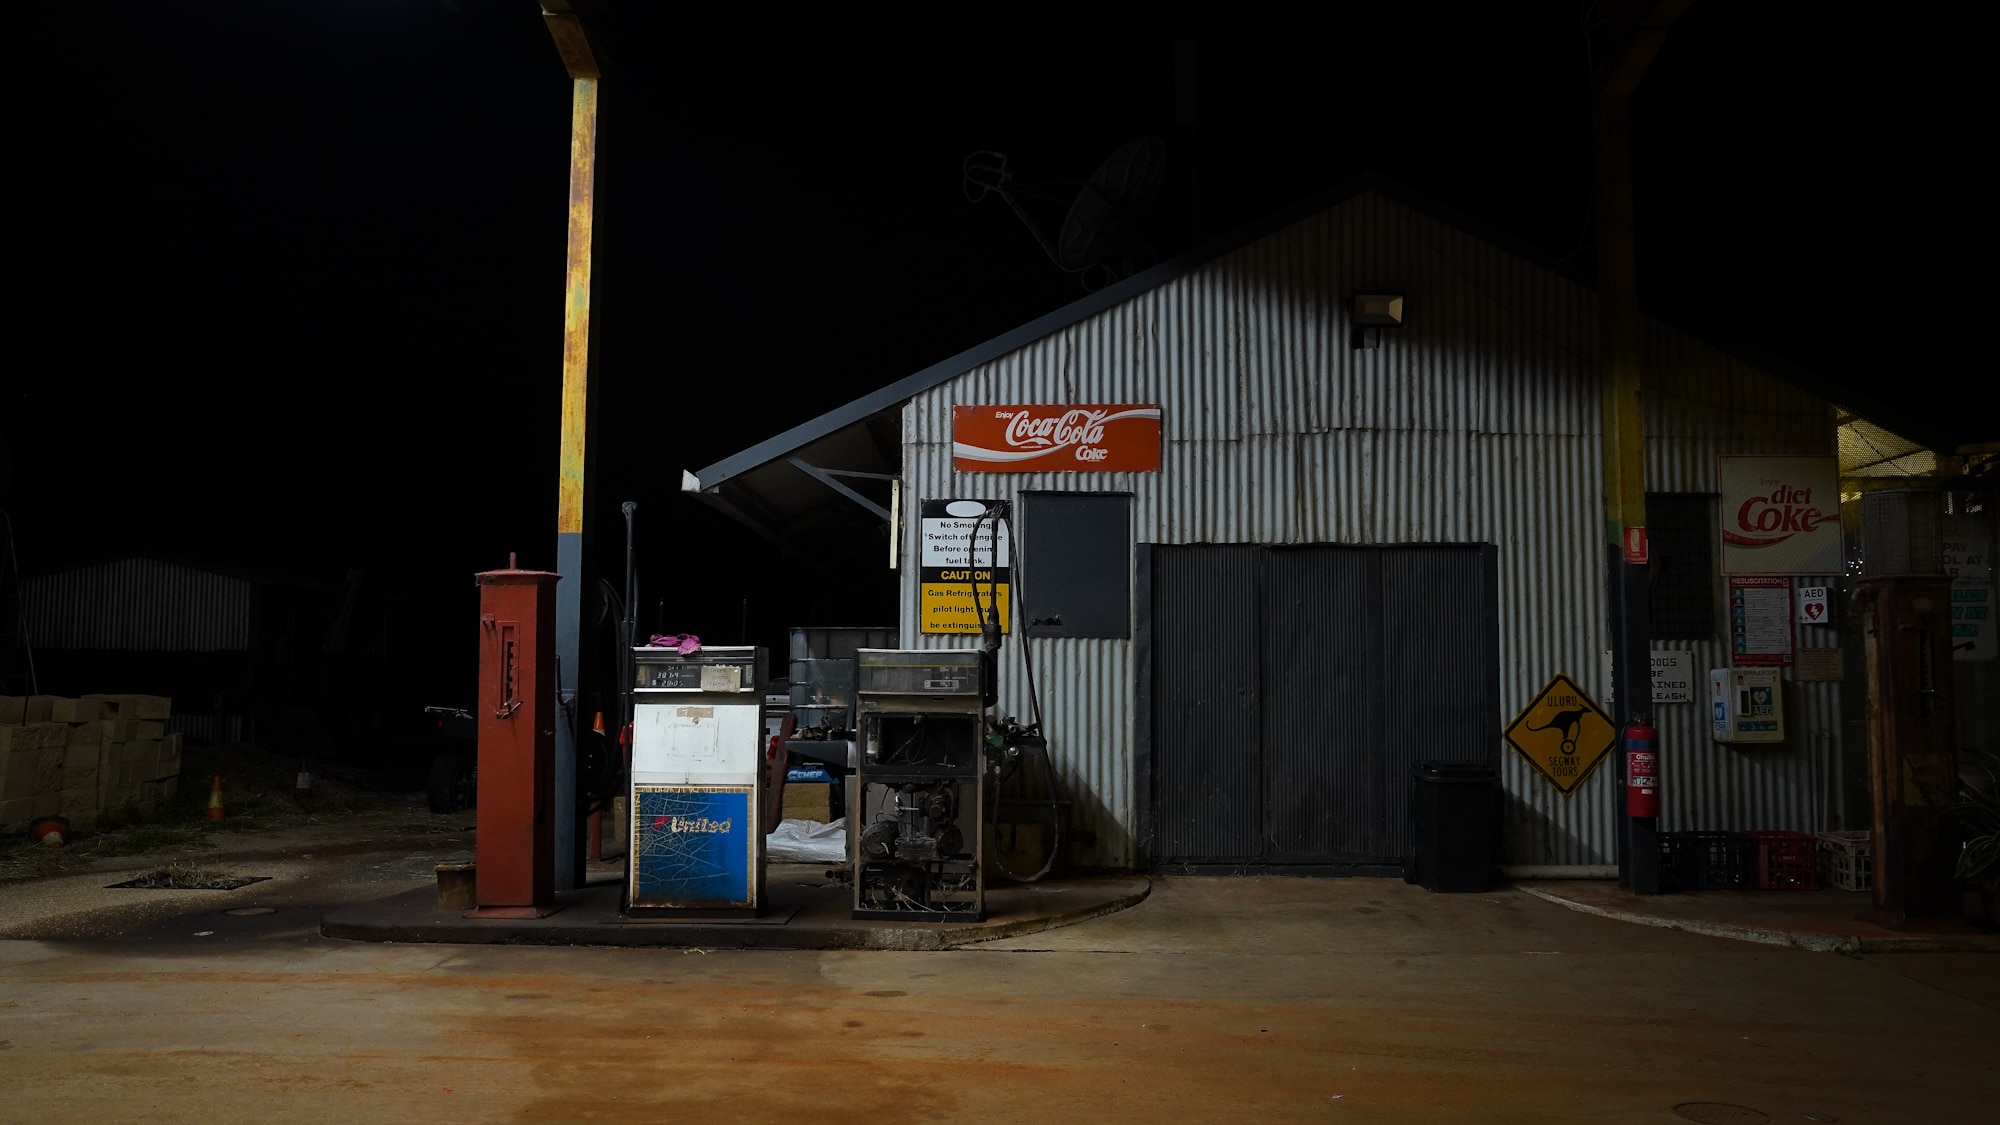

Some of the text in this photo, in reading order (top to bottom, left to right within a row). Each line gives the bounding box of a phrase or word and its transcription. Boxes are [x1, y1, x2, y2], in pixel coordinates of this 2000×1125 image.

[995, 411, 1014, 419] Enjoy
[1005, 409, 1108, 446] Coca-Cola
[1075, 445, 1108, 460] Coke
[1760, 478, 1780, 486] Enjoy
[1771, 485, 1812, 504] diet
[1738, 496, 1822, 532] Coke
[953, 521, 991, 530] Smong
[976, 533, 1003, 541] engie
[963, 545, 994, 553] oenin
[940, 570, 991, 580] CAUTON
[928, 589, 944, 597] Gas
[1804, 588, 1824, 598] AED
[933, 605, 952, 613] pilot
[954, 605, 974, 613] light
[1547, 695, 1577, 707] ULURU
[1548, 756, 1580, 767] SEGWAY
[1552, 766, 1578, 777] TOURS
[671, 815, 732, 833] United
